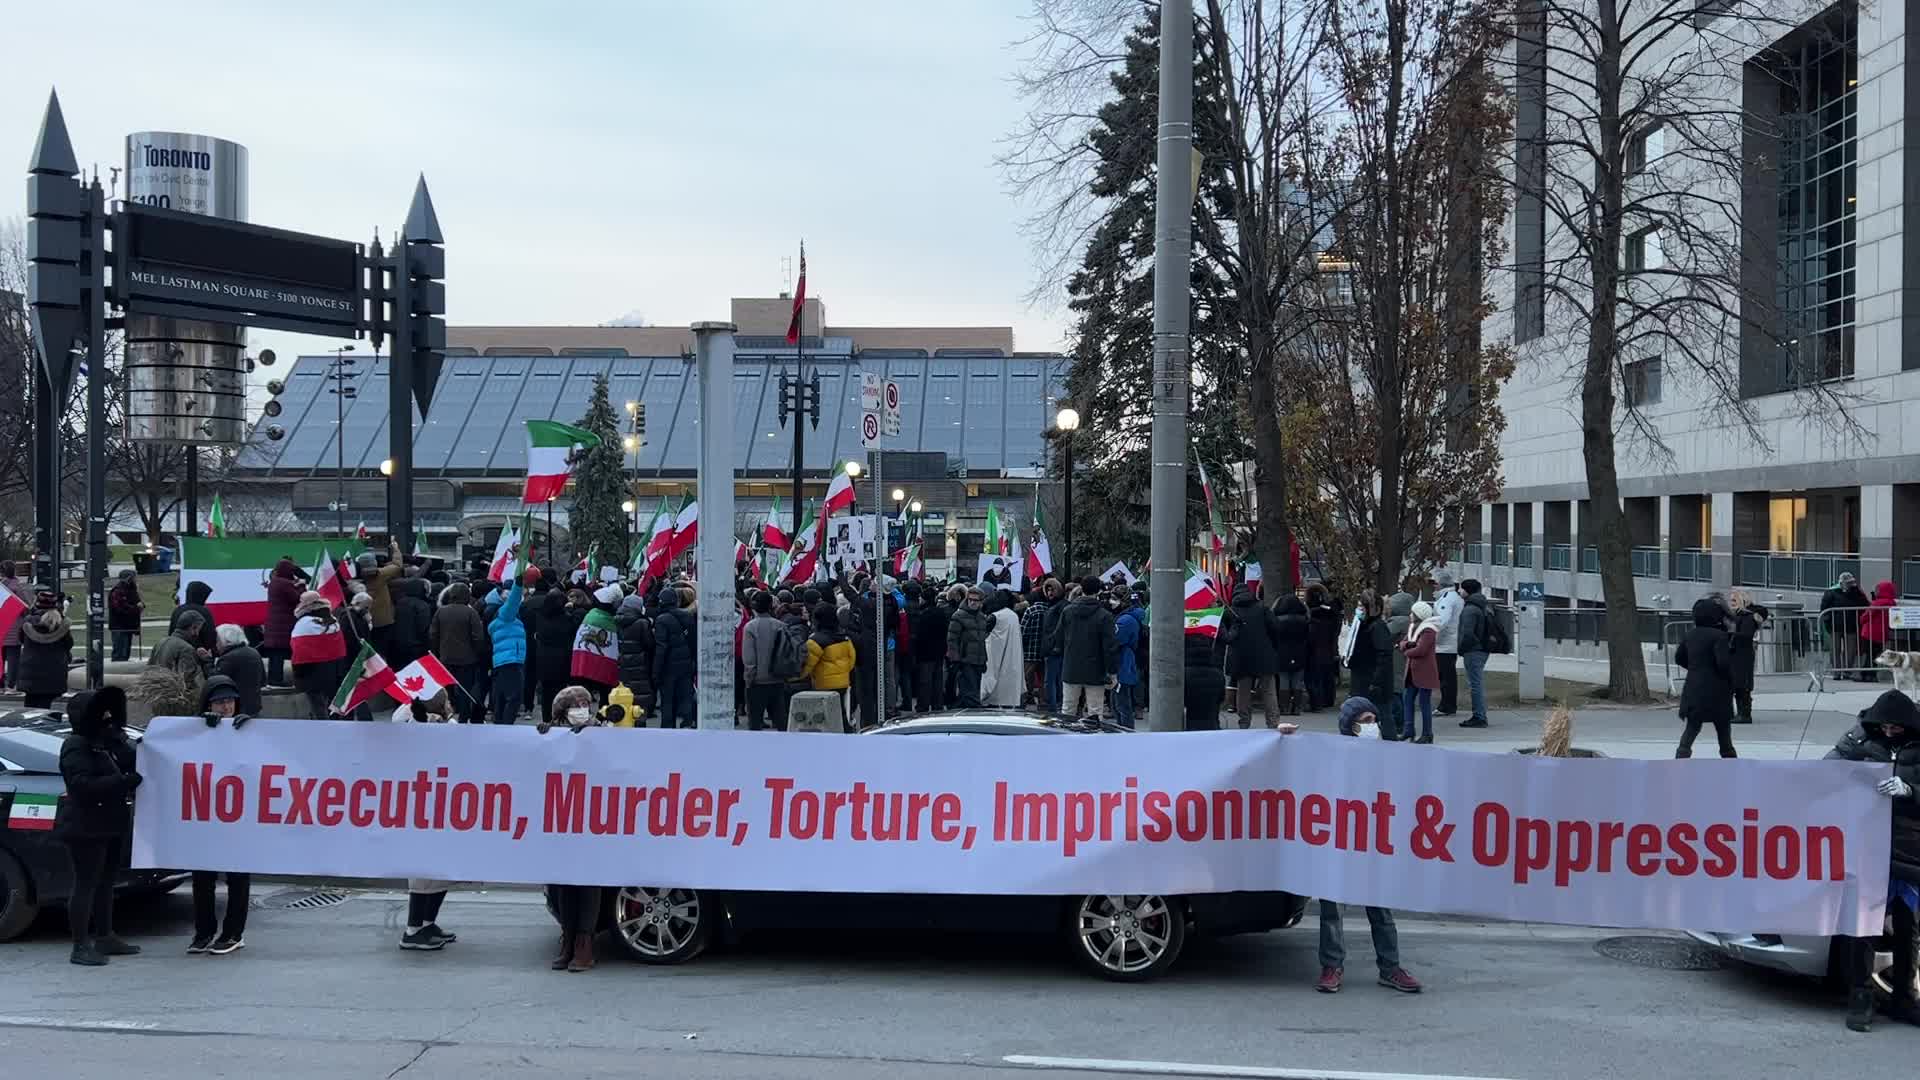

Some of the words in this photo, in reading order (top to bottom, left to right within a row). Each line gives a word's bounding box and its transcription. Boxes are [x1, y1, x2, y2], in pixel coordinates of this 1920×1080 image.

[144, 145, 211, 171] TORONTO
[131, 271, 157, 284] MEL
[161, 276, 220, 293] LASTMAN
[223, 284, 269, 300] SQUARE
[277, 291, 297, 304] 5100
[300, 295, 337, 310] YONGE
[338, 301, 354, 312] ST.
[181, 762, 245, 822] No
[258, 765, 528, 838] Execution,
[543, 772, 749, 846] Murder,
[765, 777, 978, 849] Torture,
[993, 777, 1395, 857] Imprisonment
[1411, 796, 1453, 861] &
[1474, 803, 1845, 887] Oppression
